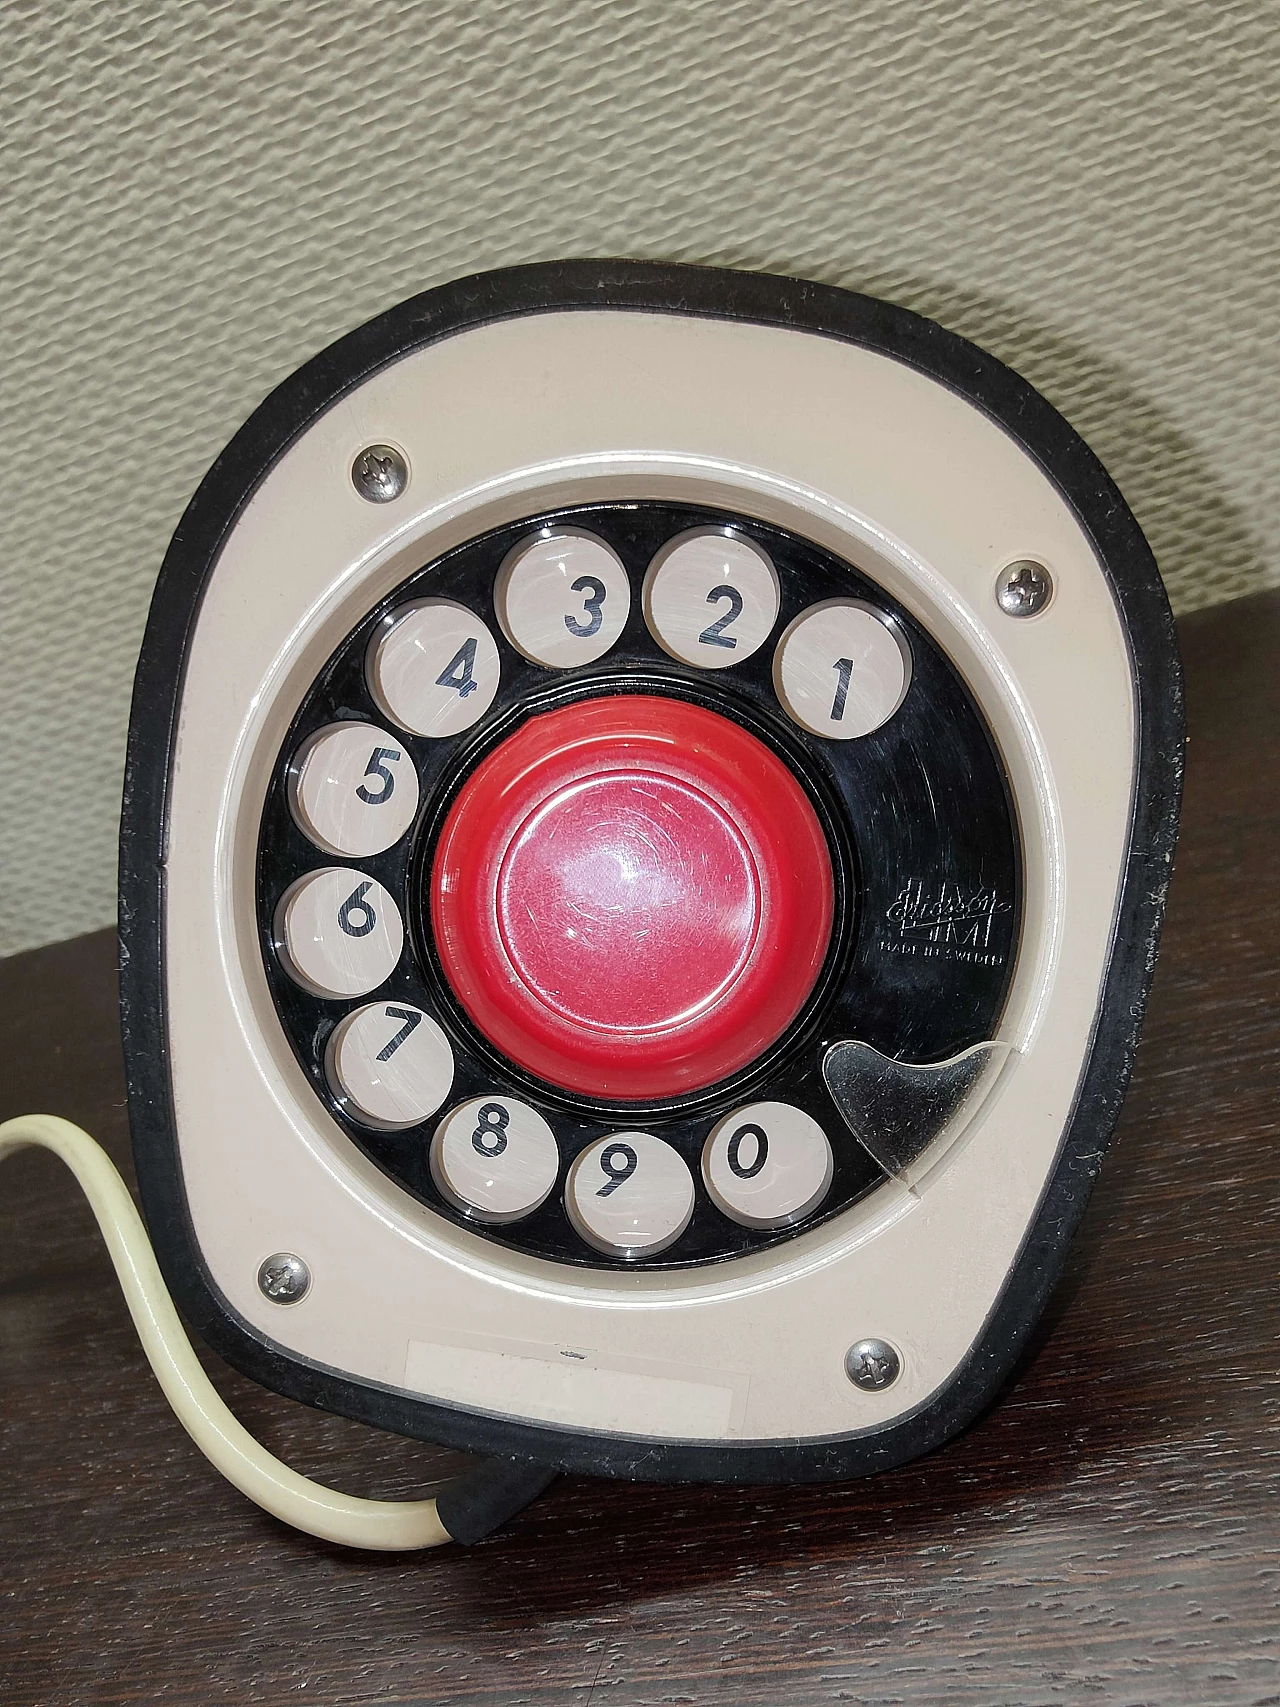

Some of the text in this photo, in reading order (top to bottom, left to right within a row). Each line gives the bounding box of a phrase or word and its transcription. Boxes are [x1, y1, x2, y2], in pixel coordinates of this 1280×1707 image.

[564, 575, 607, 638] 3
[697, 584, 743, 649] 2
[435, 637, 478, 698] 4
[830, 657, 854, 721] 1
[355, 747, 401, 806] 5
[337, 880, 378, 938] 6
[375, 1006, 423, 1063] 7
[471, 1102, 511, 1159] 8
[727, 1123, 770, 1180] 0
[595, 1142, 639, 1199] 9
